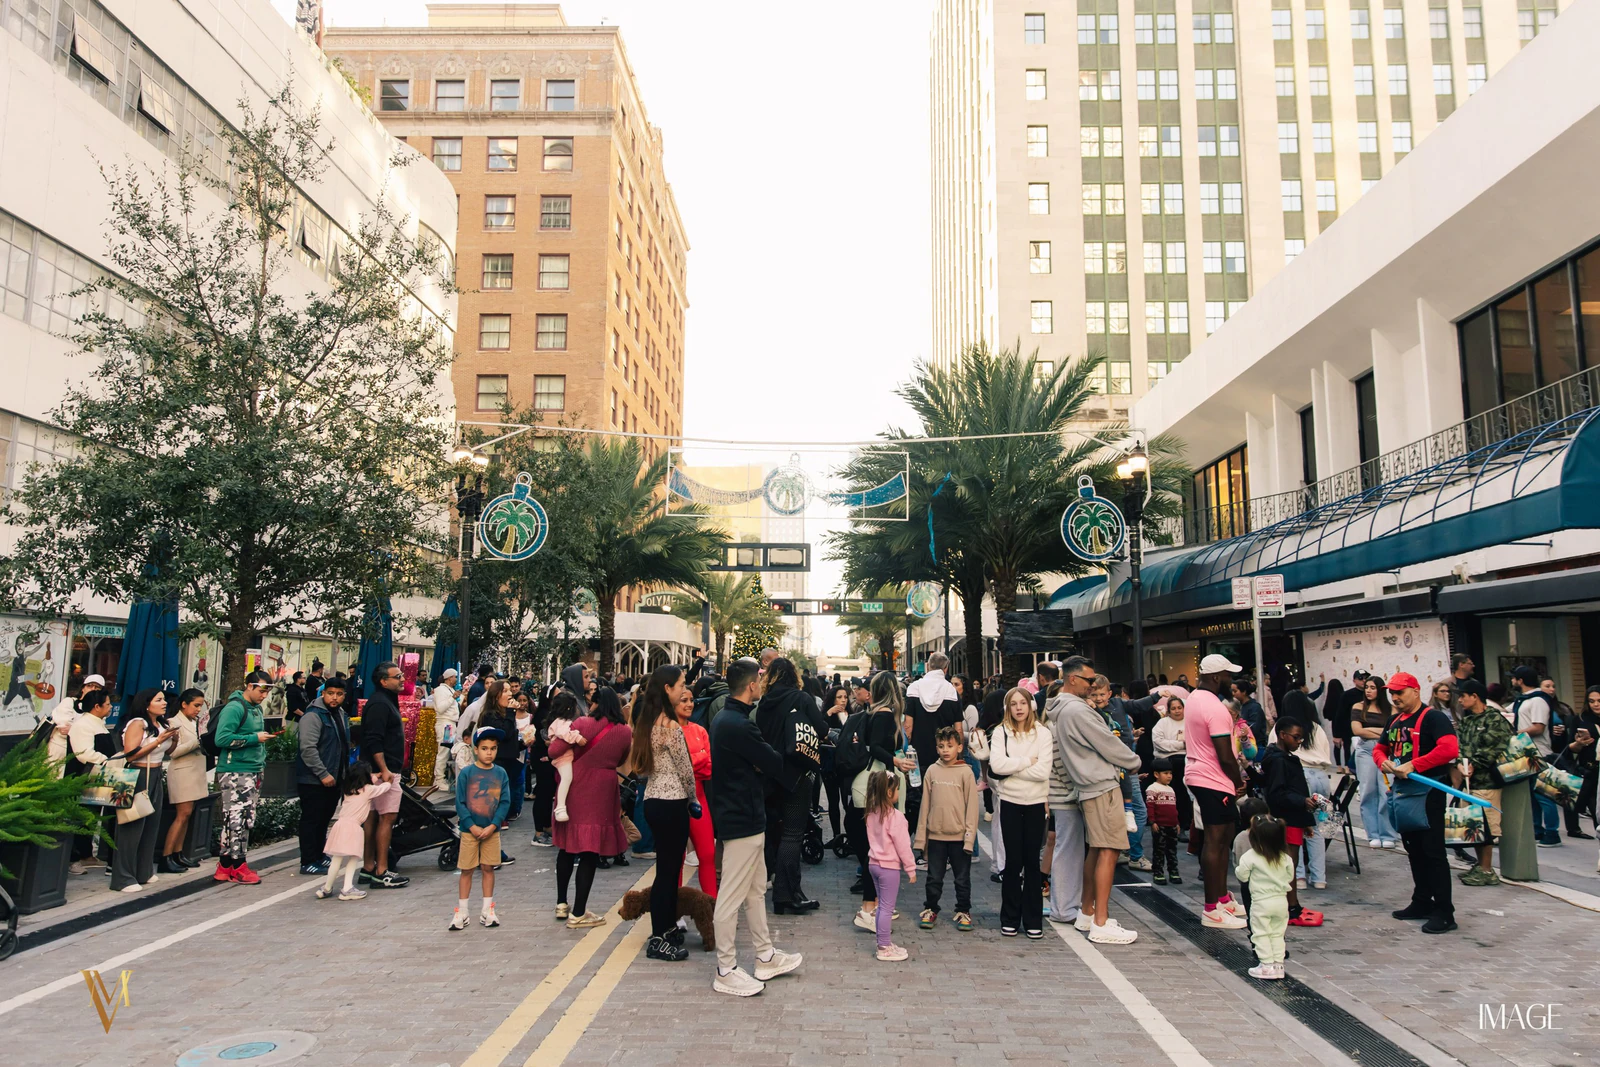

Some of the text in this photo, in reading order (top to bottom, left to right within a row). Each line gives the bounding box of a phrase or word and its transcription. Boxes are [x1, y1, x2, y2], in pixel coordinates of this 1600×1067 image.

[92, 626, 115, 635] FULL BAR
[1338, 625, 1390, 635] RESOLUTION
[1394, 621, 1420, 630] WALL
